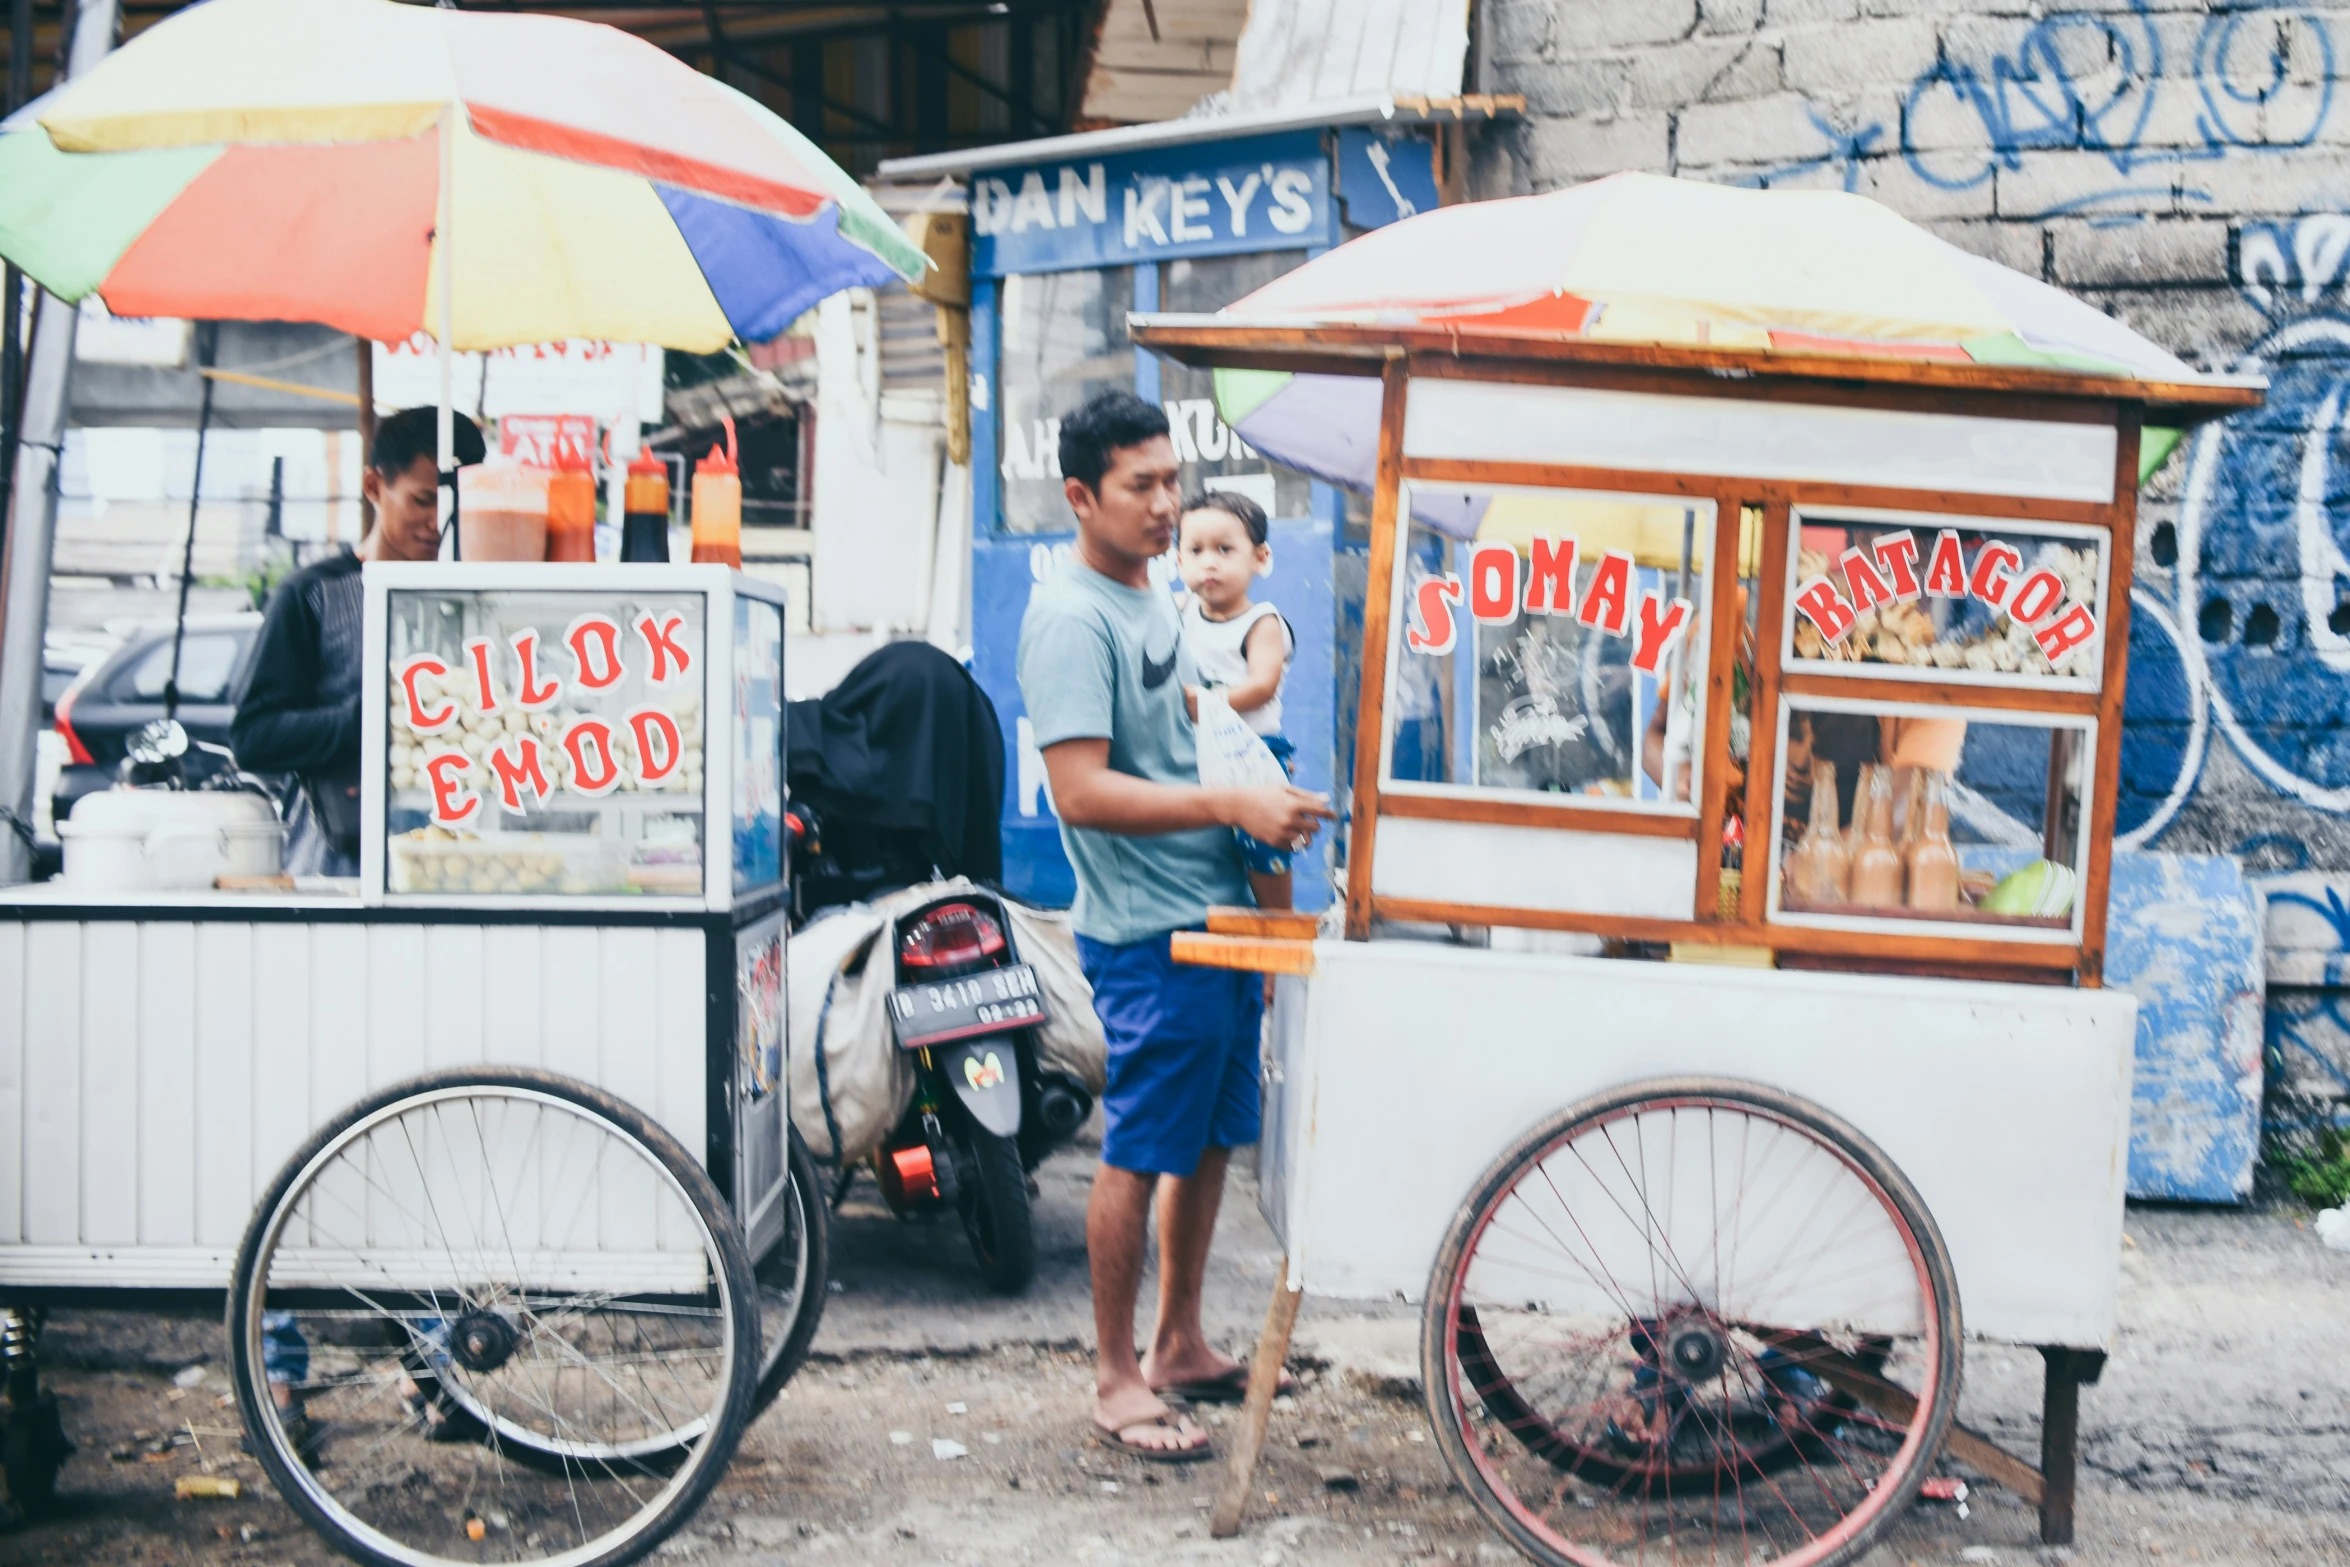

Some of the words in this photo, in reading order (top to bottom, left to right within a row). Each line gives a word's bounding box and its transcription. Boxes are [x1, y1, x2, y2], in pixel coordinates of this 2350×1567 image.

[973, 163, 1107, 236] DAN
[1124, 163, 1313, 248] KEY'S
[1407, 534, 1688, 674] SOMAY
[1793, 530, 2097, 668] BATAGOR
[400, 615, 692, 730] CILOK
[425, 709, 682, 822] EMOD
